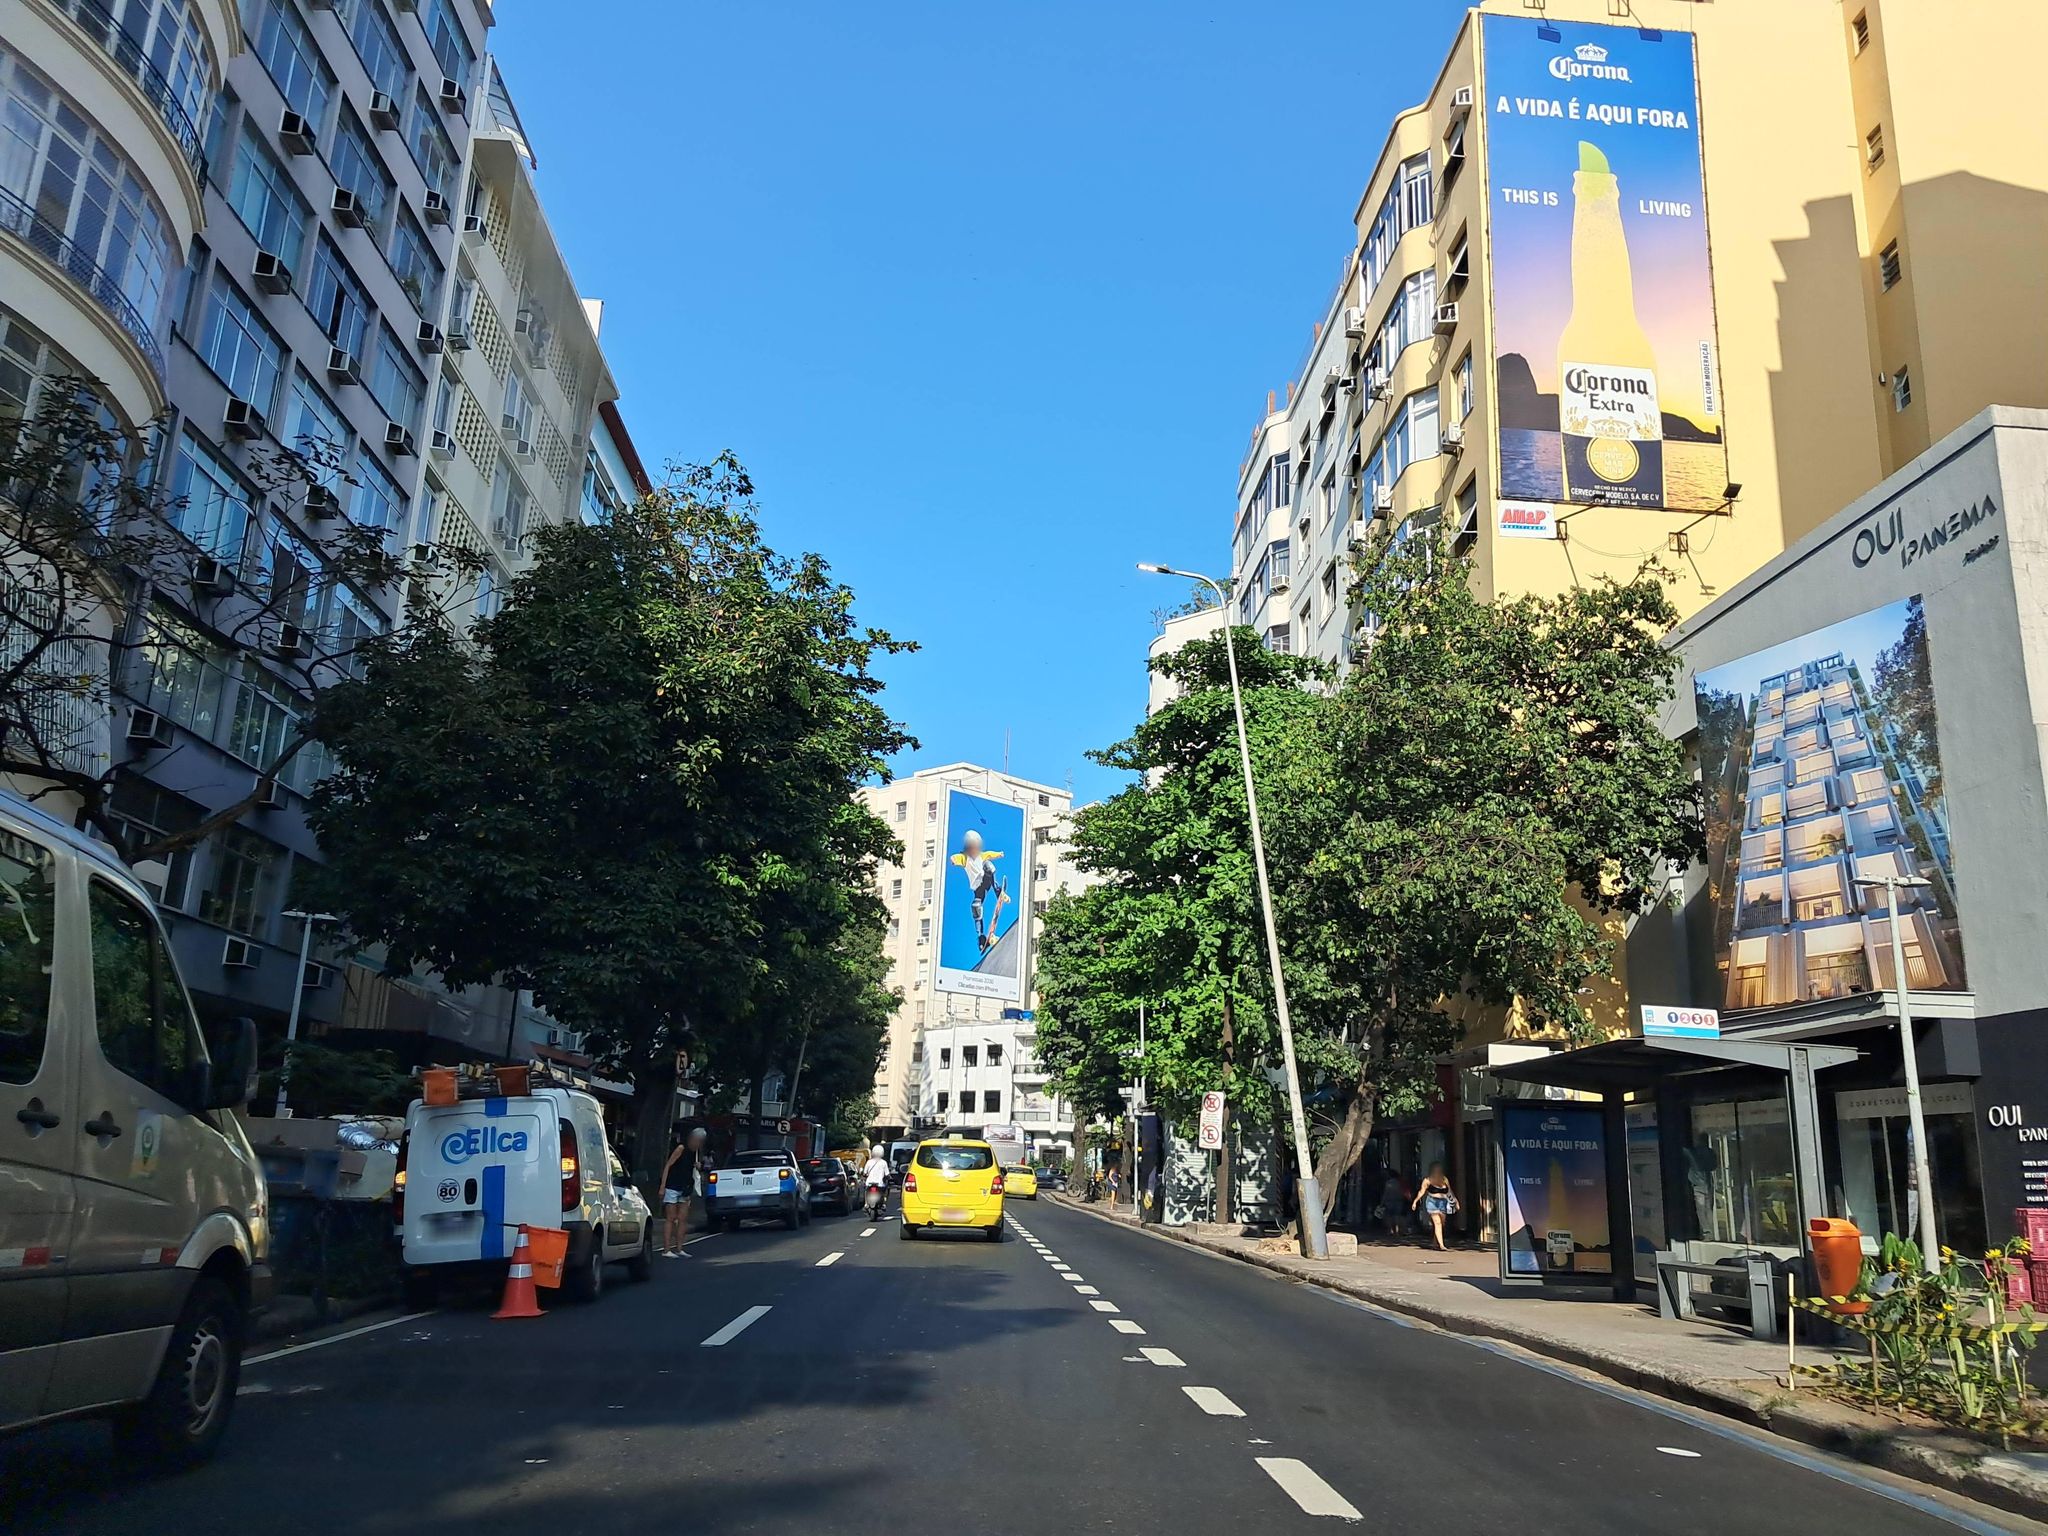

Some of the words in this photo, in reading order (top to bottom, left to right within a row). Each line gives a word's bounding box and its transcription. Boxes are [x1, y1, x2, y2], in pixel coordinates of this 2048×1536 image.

[1549, 56, 1632, 83] Corona
[1496, 95, 1511, 113] A
[1515, 97, 1563, 118] VIDA
[1568, 97, 1581, 120] É
[1586, 104, 1633, 126] AQUI
[1637, 108, 1689, 129] FORA
[1502, 188, 1539, 205] THIS
[1543, 191, 1559, 207] IS
[1639, 199, 1692, 218] LIVING
[1565, 367, 1650, 397] Corona
[1589, 394, 1635, 414] Extra
[1501, 509, 1546, 524] AM&P
[1852, 507, 1904, 568] OUI
[1901, 494, 1997, 569] IPANEMA
[1988, 1105, 2022, 1127] OUI
[2018, 1127, 2048, 1141] IPAN
[1511, 1139, 1518, 1148] A
[1520, 1139, 1541, 1148] VIDA
[1552, 1140, 1572, 1151] AQUI
[1575, 1141, 1598, 1150] FORA
[439, 1187, 457, 1197] 80
